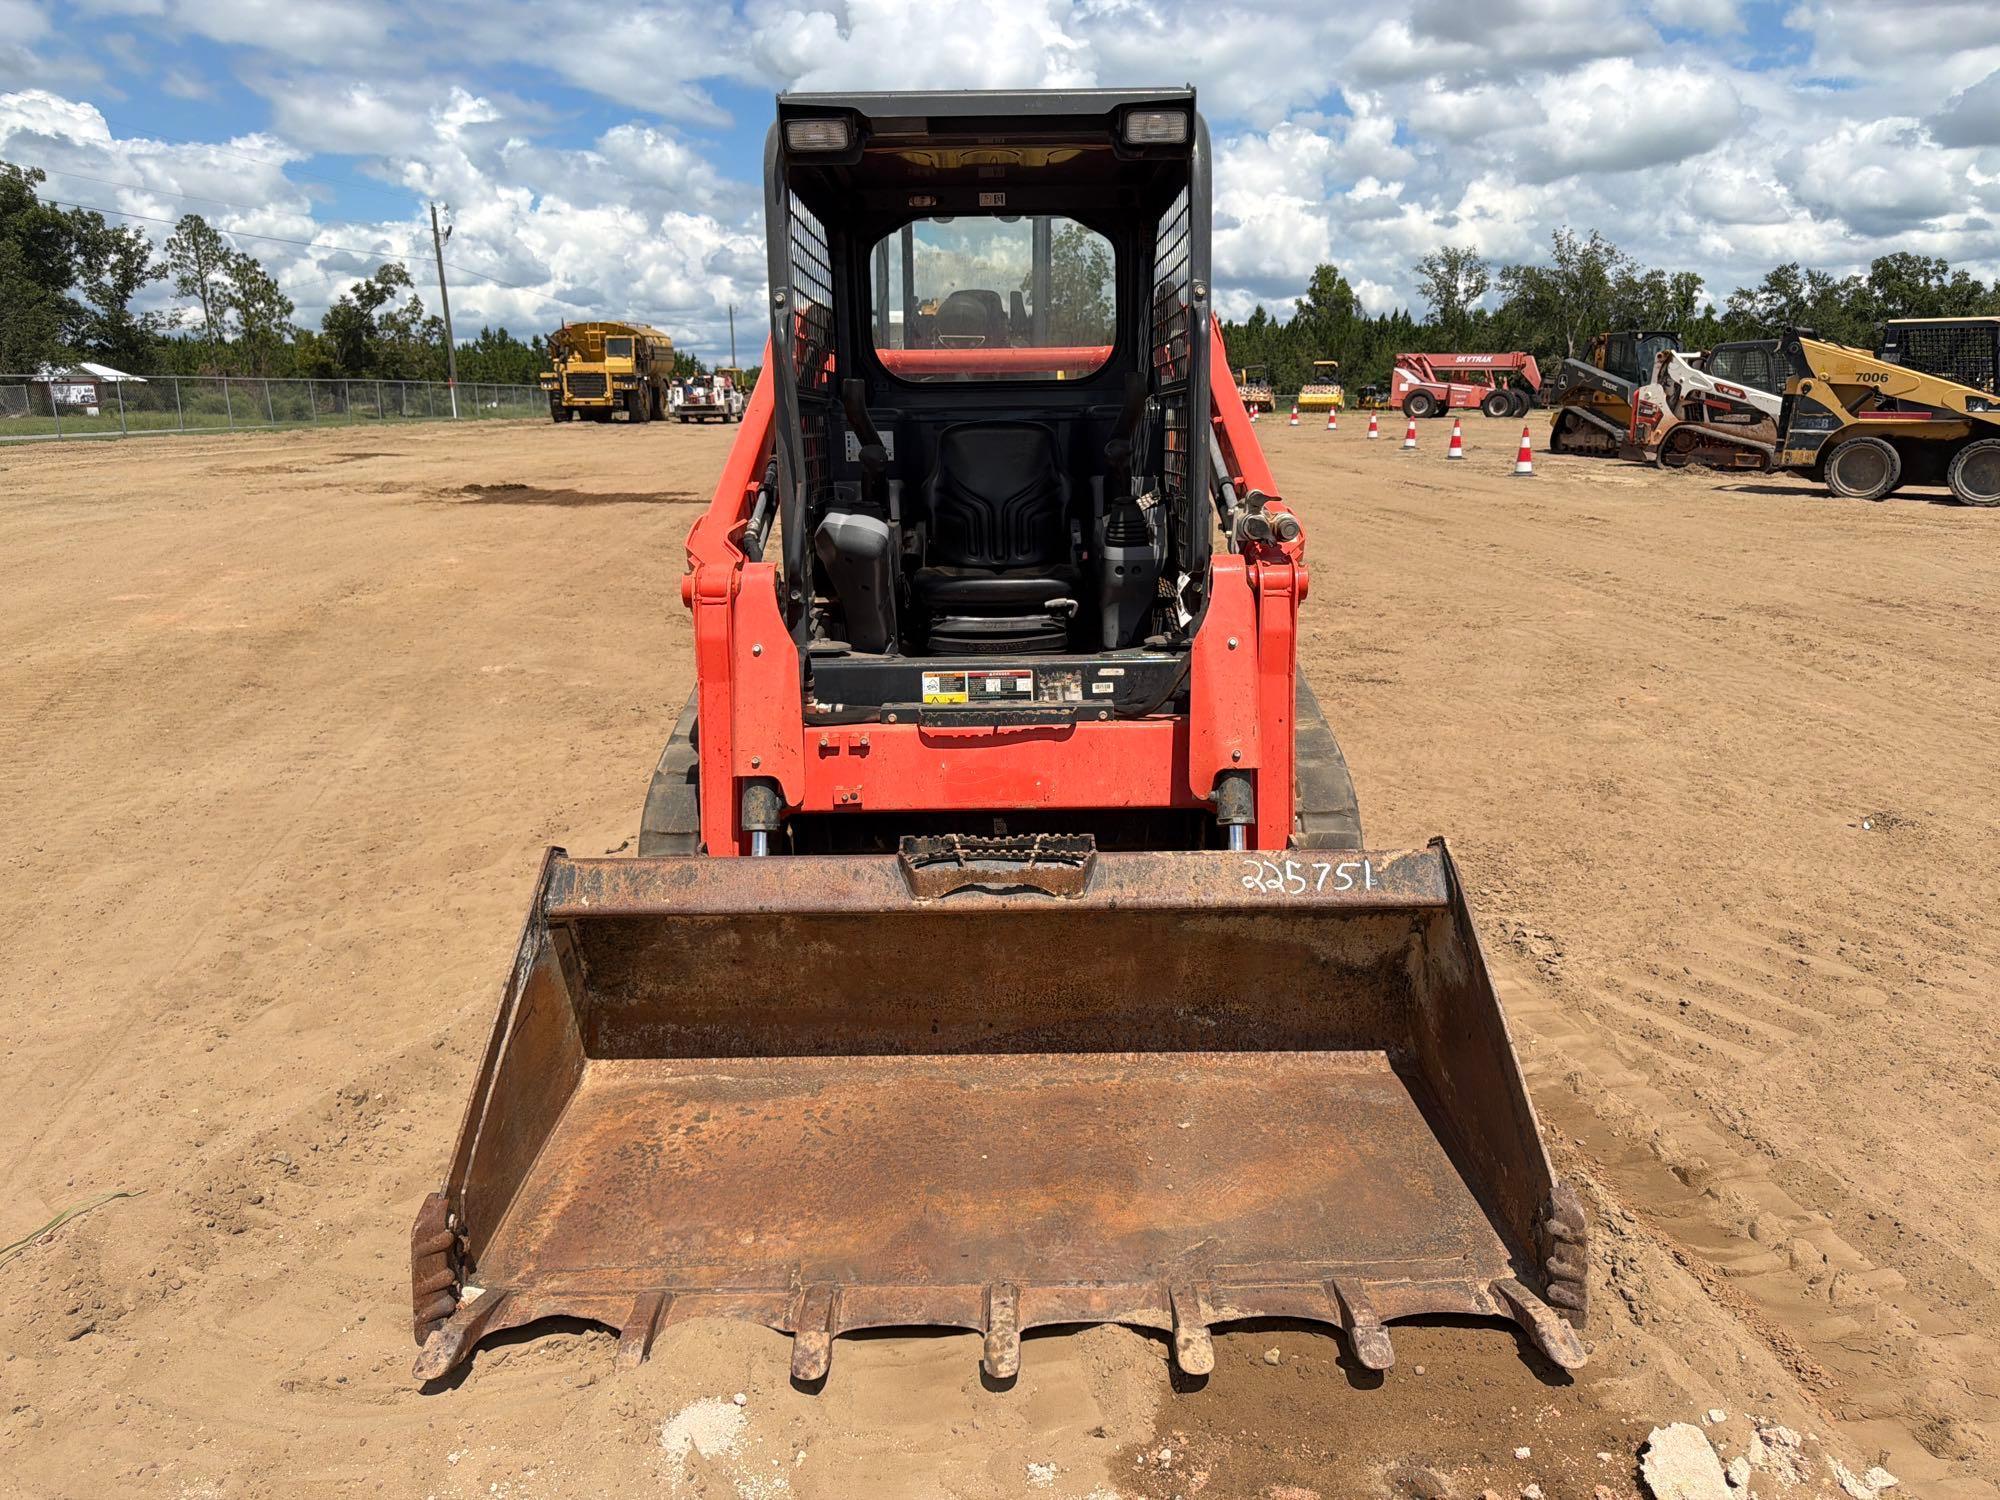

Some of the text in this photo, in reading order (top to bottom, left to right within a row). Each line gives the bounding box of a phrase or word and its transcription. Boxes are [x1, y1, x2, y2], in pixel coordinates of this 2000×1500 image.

[1455, 355, 1493, 363] SKYTRAK
[1855, 372, 1889, 382] 7006
[1242, 859, 1371, 895] 225751
